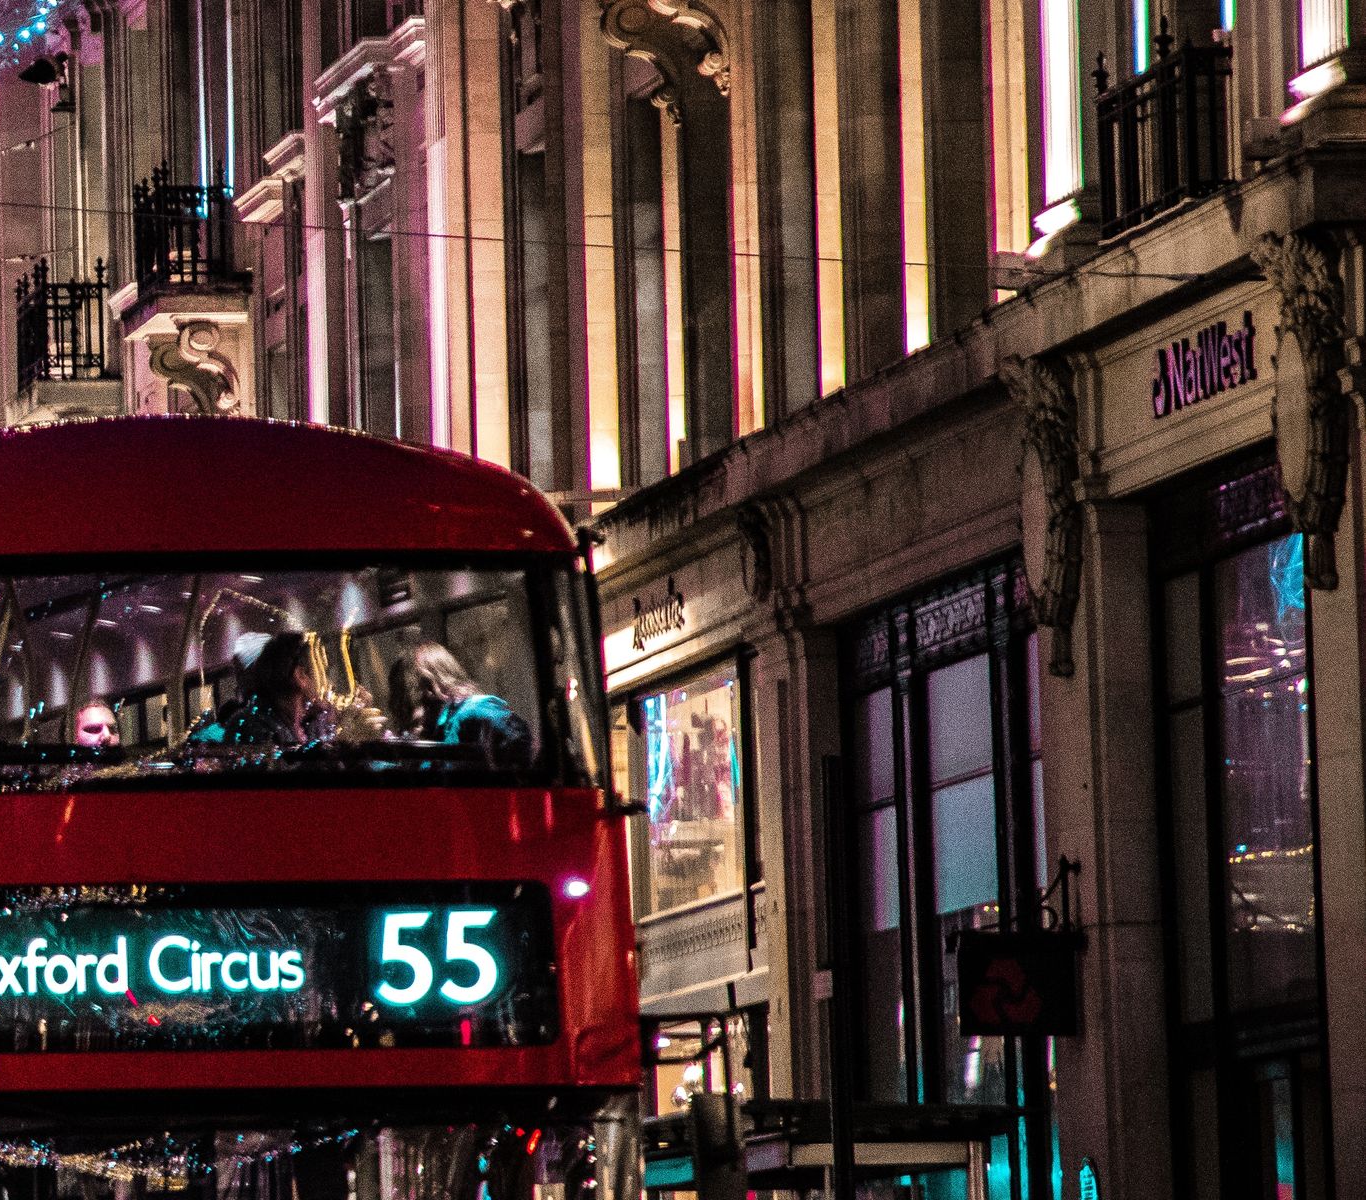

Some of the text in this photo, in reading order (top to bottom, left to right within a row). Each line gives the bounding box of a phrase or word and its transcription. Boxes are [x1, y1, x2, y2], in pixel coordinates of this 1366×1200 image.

[1167, 310, 1257, 412] NatWest
[148, 933, 305, 993] Circus
[374, 909, 498, 1005] 55
